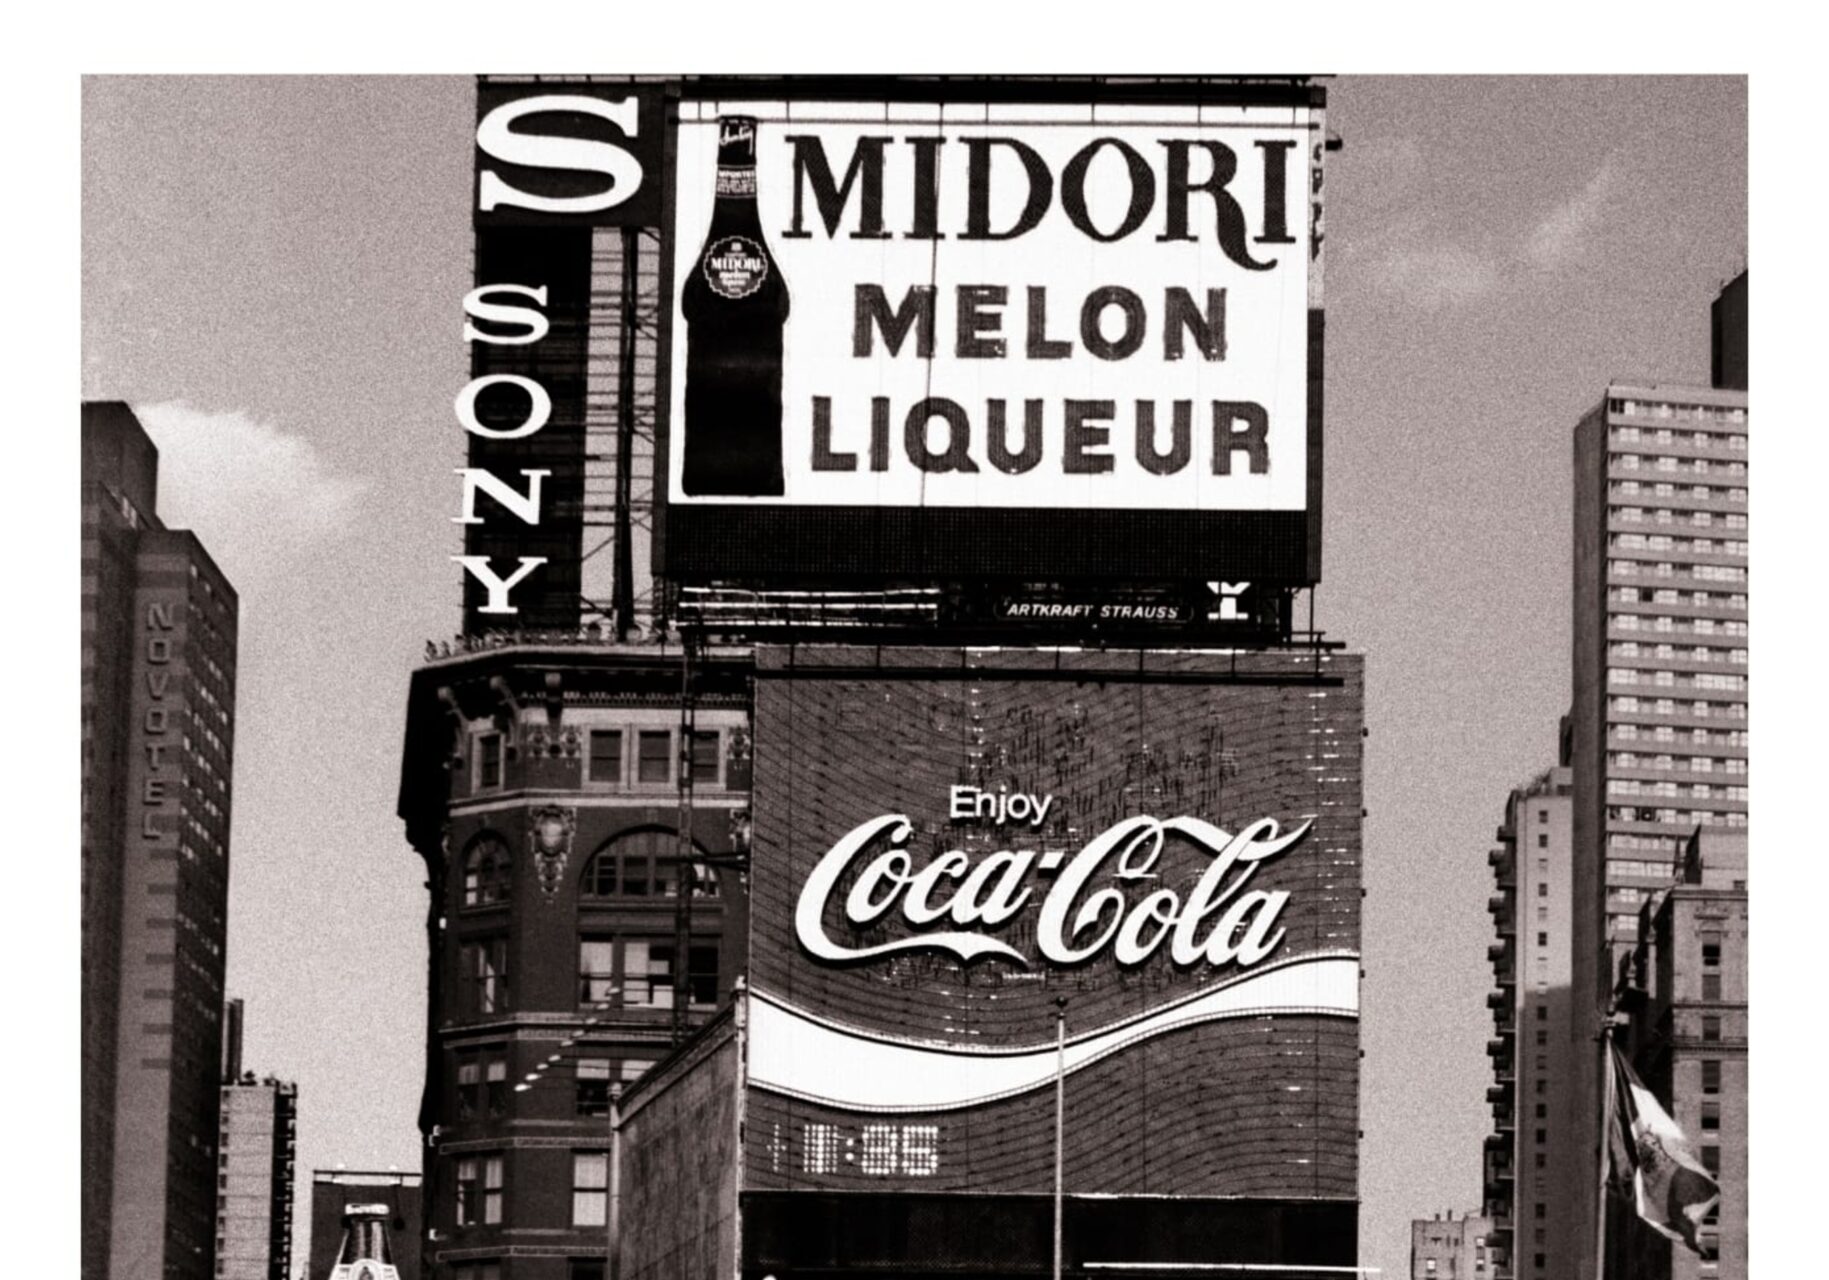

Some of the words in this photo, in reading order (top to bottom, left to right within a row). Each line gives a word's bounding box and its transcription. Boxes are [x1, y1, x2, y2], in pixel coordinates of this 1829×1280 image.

[477, 95, 643, 213] S
[782, 135, 1297, 271] MIDORI
[711, 257, 761, 272] MIDORI
[853, 283, 1227, 361] MELON
[451, 284, 552, 613] SONY
[811, 395, 1271, 476] LIQUEUR
[1006, 603, 1093, 617] ARTKRAFT
[1100, 604, 1179, 619] STRAUSS
[142, 602, 173, 840] NOVOTEL
[949, 785, 1053, 824] Enjoy
[796, 814, 1318, 969] Coca-Cola
